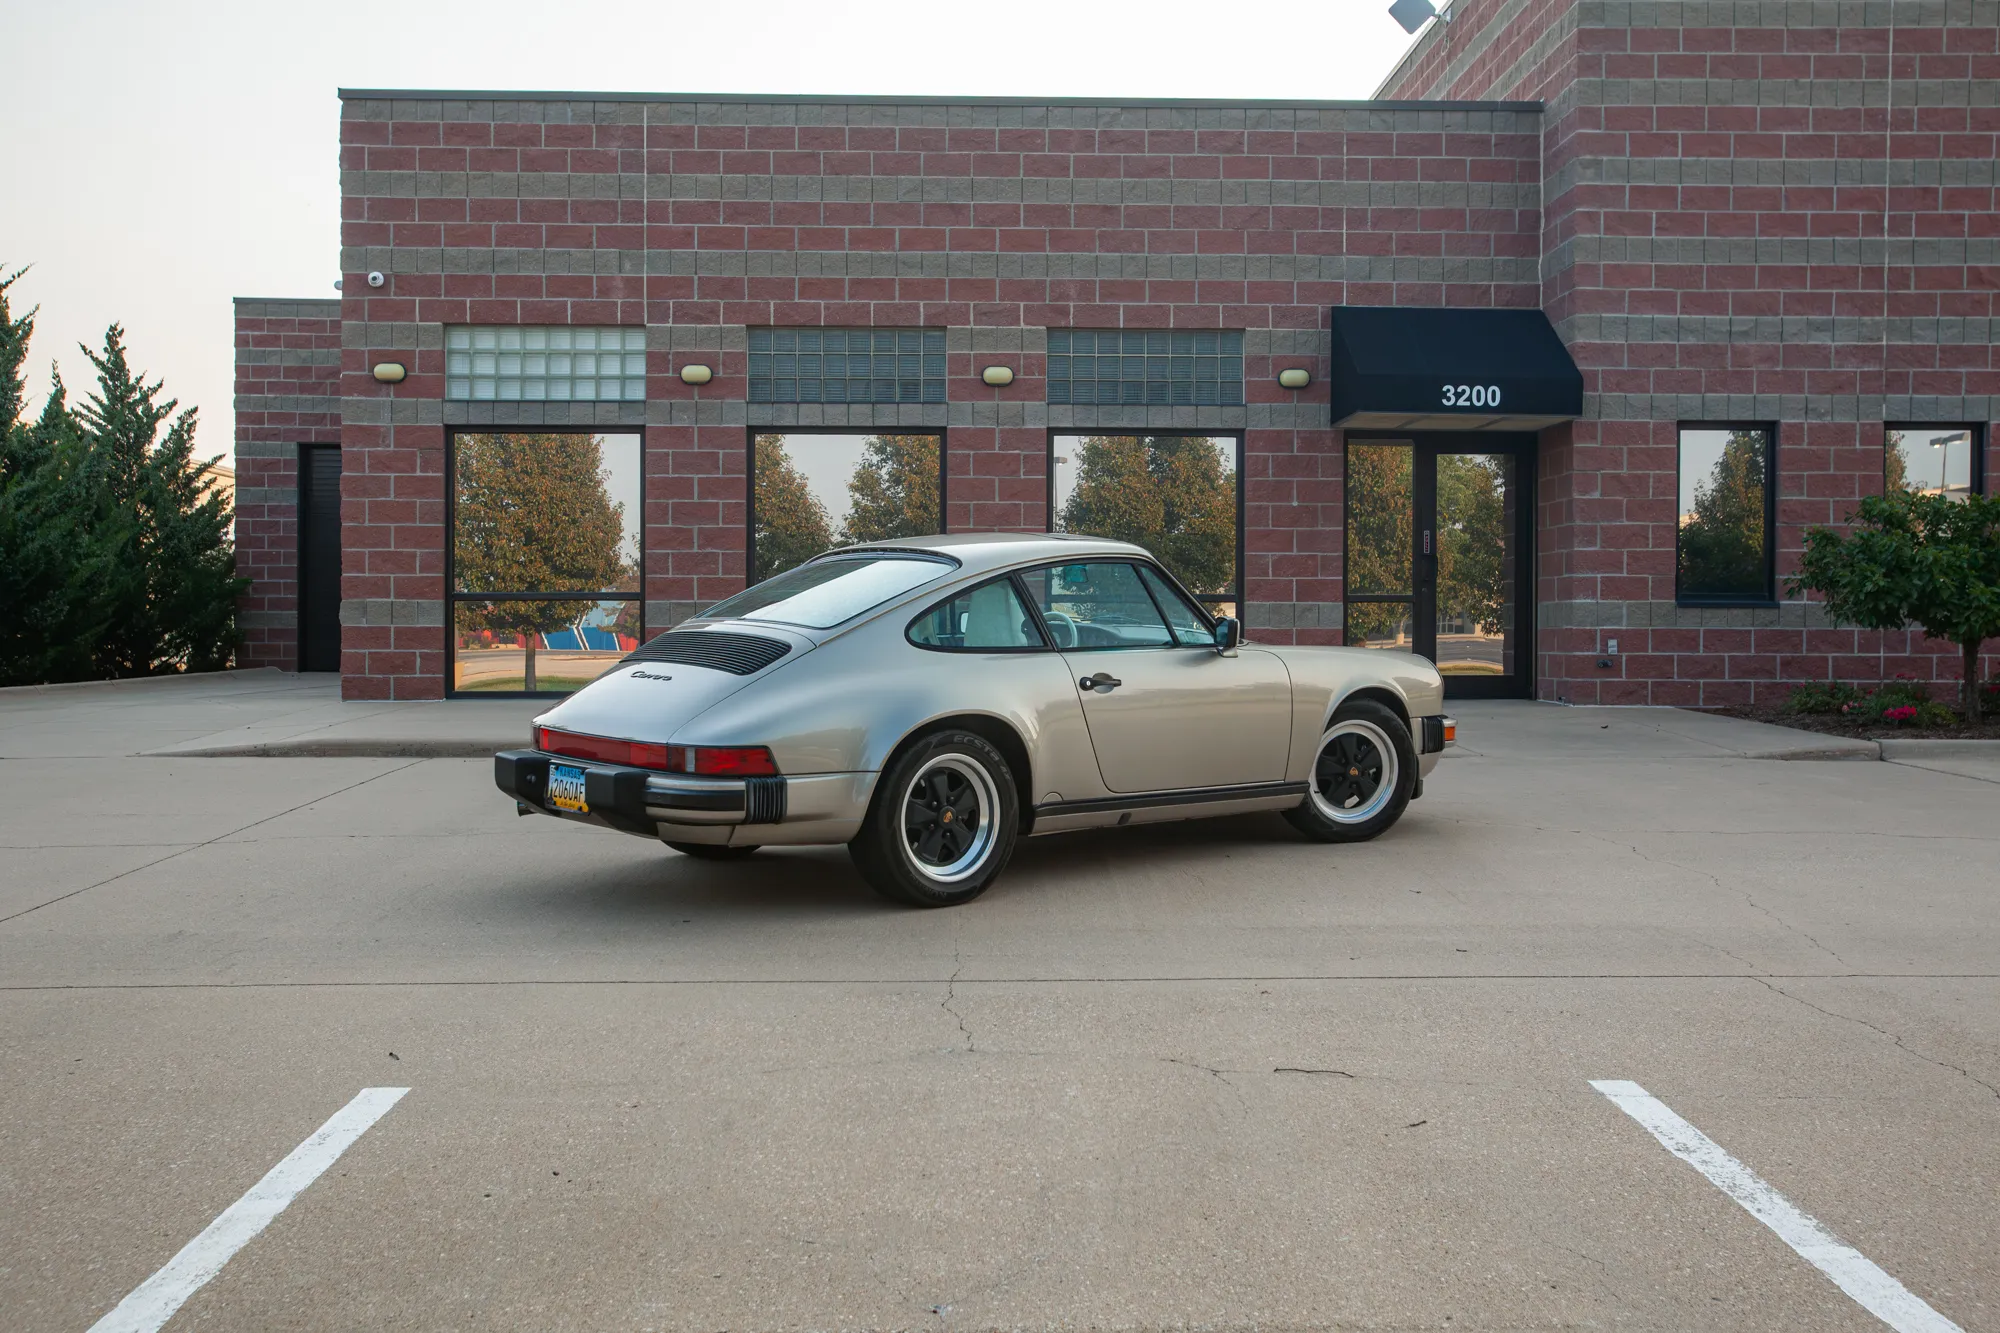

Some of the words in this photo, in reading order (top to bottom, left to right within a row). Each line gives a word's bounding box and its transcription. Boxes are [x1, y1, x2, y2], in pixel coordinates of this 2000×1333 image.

[1441, 384, 1501, 407] 3200
[559, 766, 582, 780] KANSAS
[553, 778, 585, 803] 2060AF
